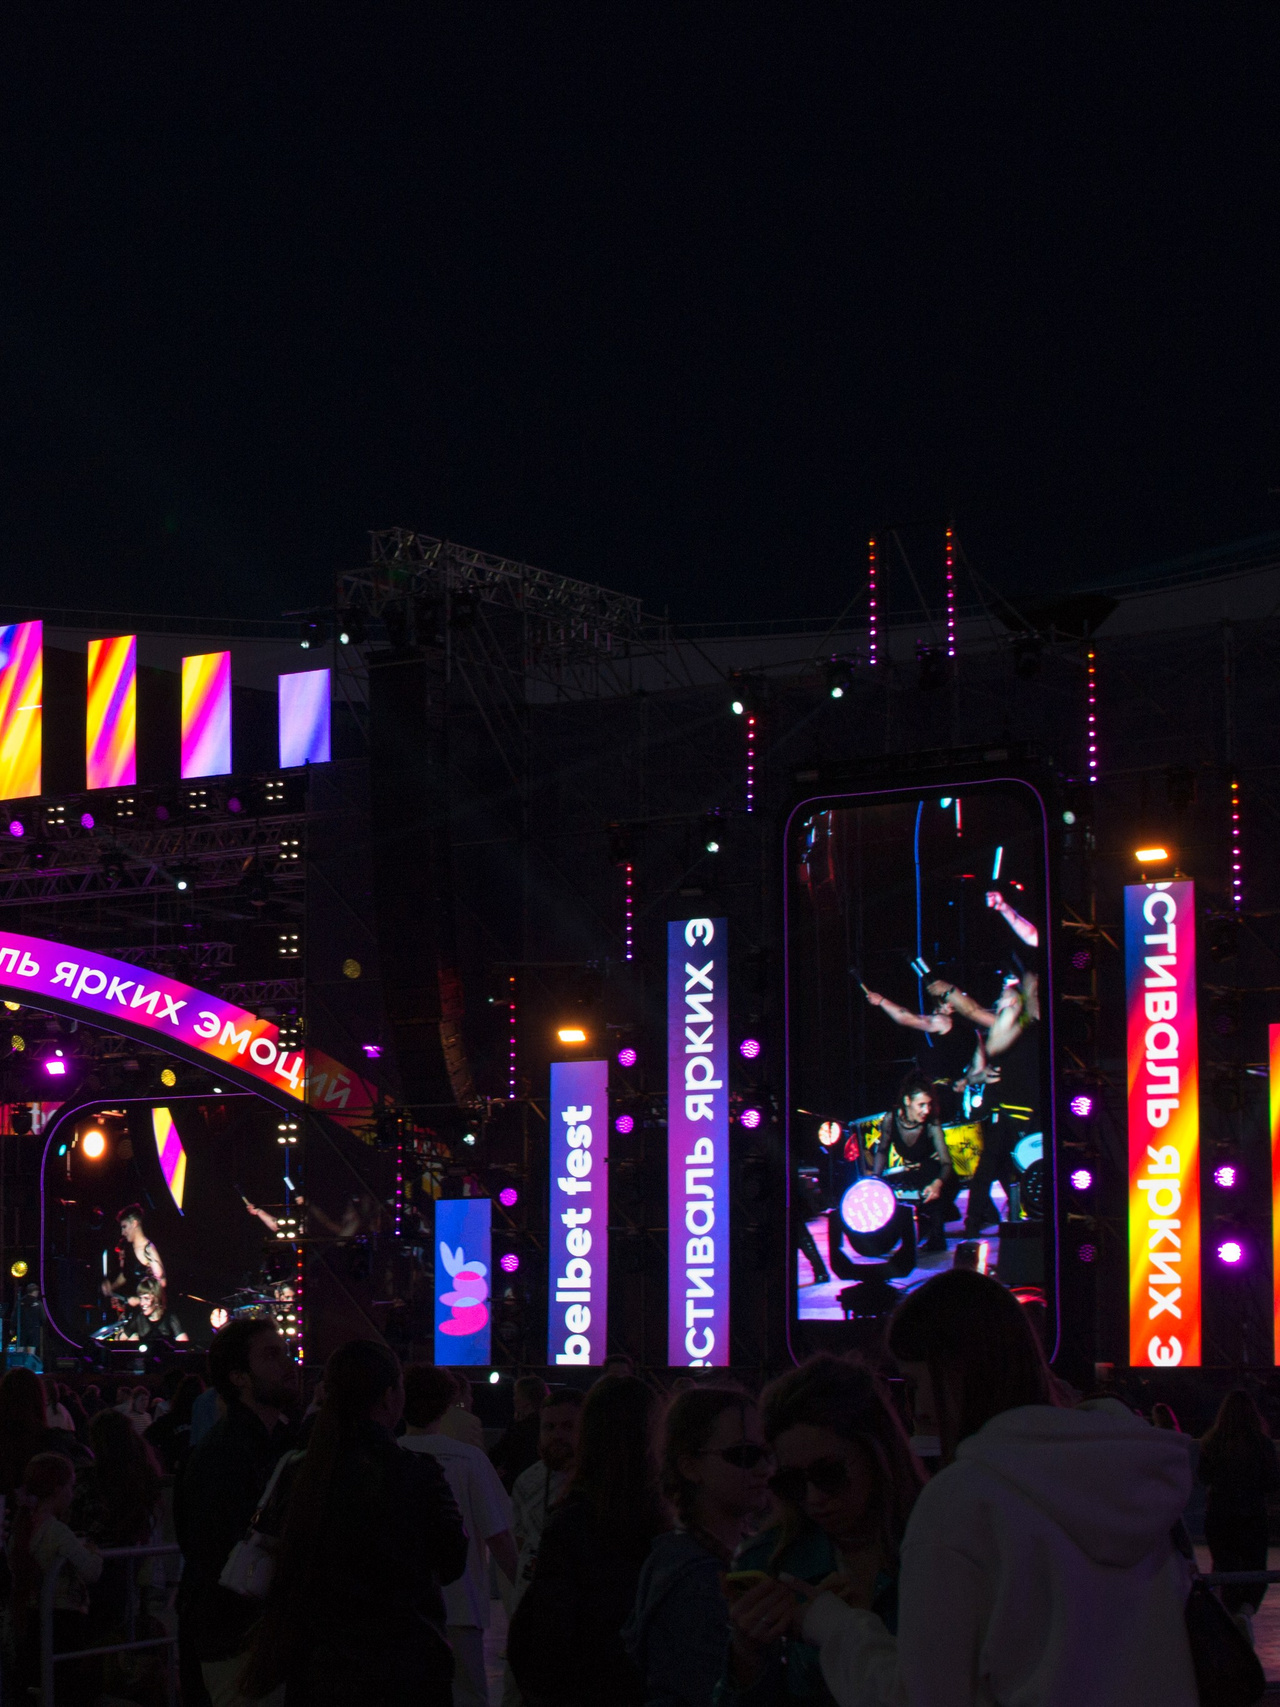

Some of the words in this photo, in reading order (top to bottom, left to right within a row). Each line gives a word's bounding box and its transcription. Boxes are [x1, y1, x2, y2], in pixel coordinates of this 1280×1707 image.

[50, 961, 188, 1026] ярких
[193, 1011, 351, 1109] эмоций
[685, 960, 723, 1122] ярких
[1143, 882, 1180, 1128] стиваль
[557, 1105, 593, 1196] fest
[556, 1208, 593, 1365] belbet
[684, 1136, 716, 1367] стиваль
[1137, 1145, 1182, 1320] ярких
